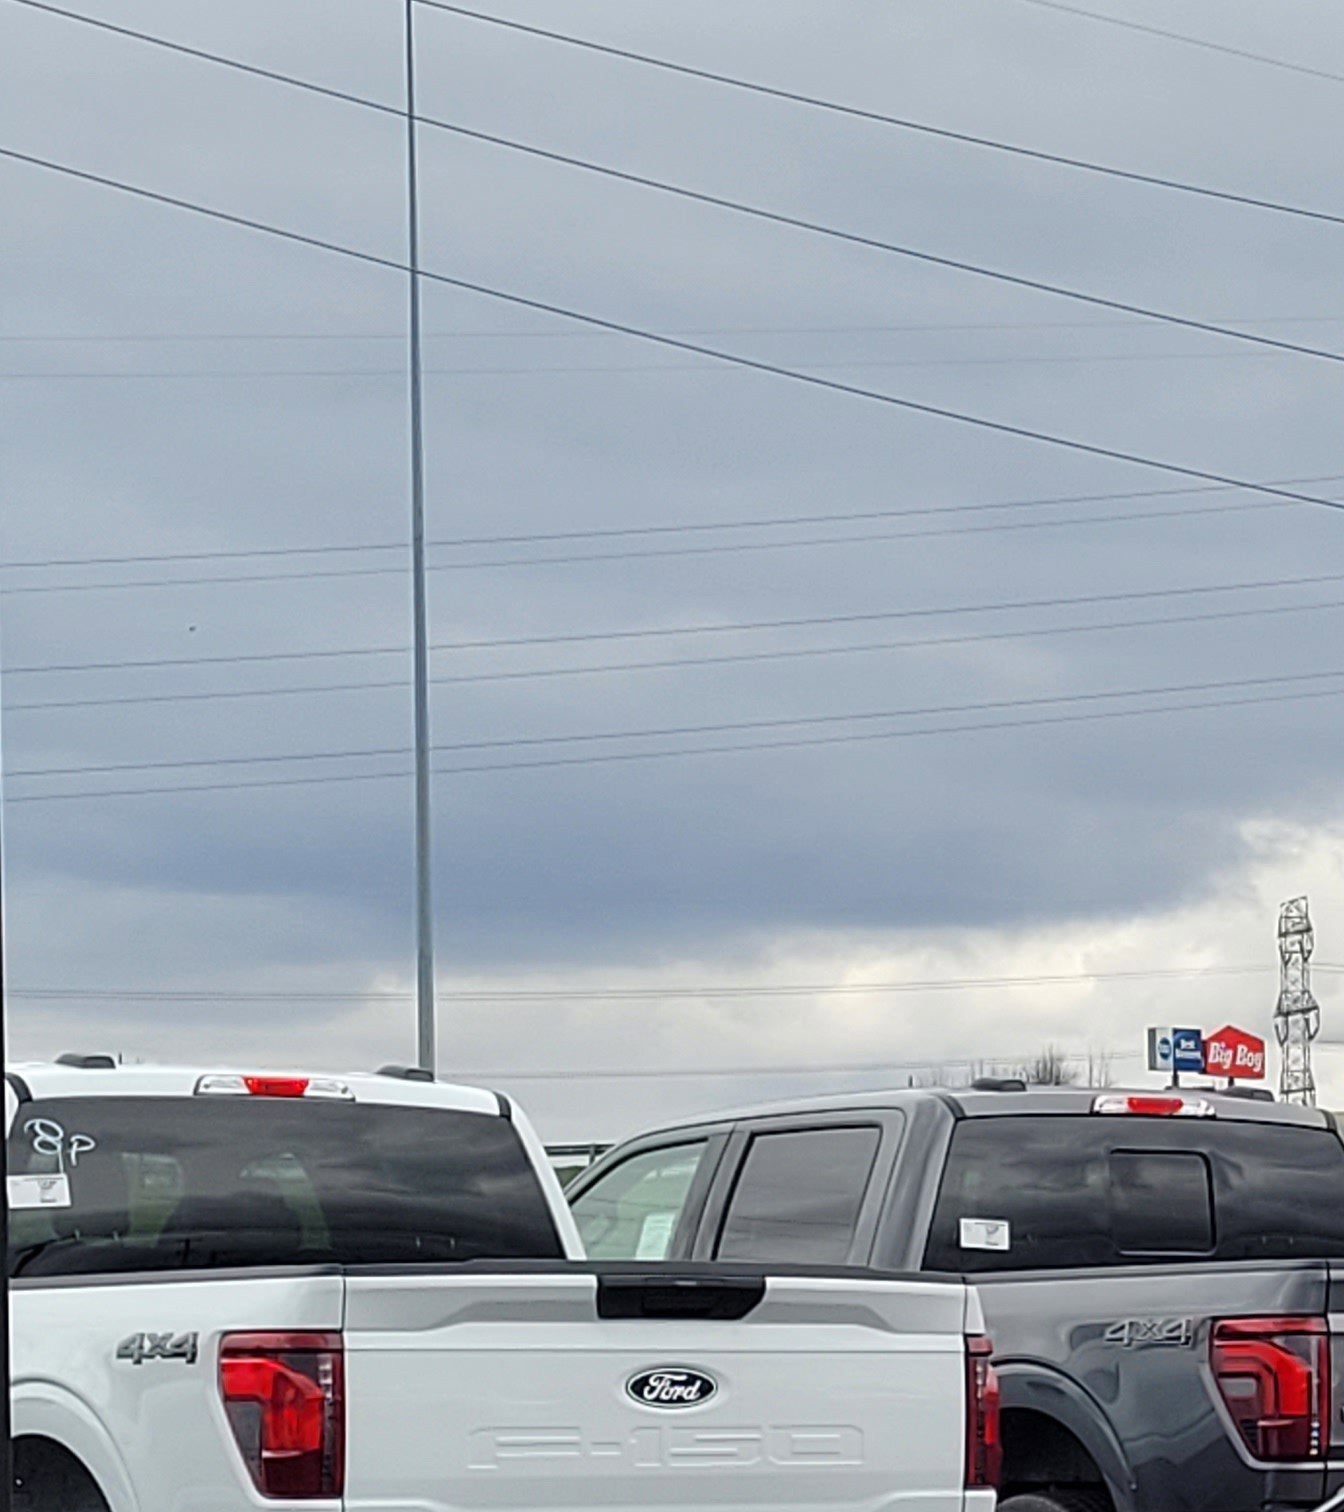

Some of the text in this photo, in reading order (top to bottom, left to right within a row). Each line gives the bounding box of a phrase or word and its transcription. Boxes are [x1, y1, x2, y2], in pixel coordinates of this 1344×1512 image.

[1208, 1042, 1233, 1069] Big
[1235, 1044, 1263, 1072] Boy
[642, 1372, 701, 1402] Ford
[467, 1424, 863, 1469] F-150
